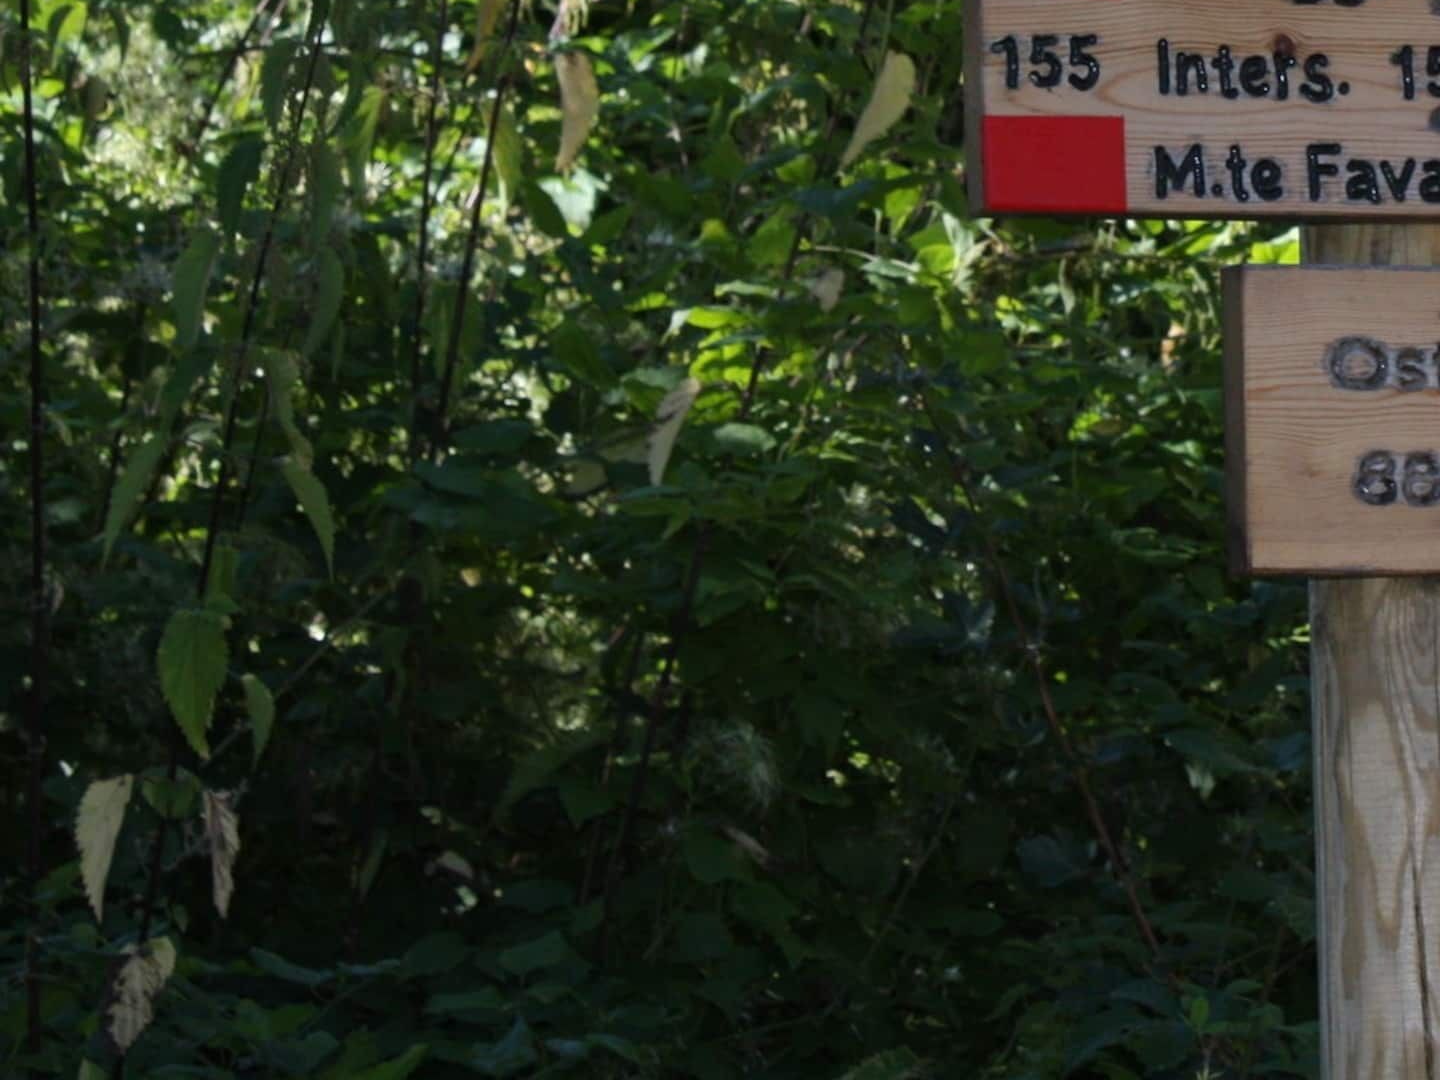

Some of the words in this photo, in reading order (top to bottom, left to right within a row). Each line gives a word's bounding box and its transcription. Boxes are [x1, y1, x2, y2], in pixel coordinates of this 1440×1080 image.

[990, 33, 1100, 91] 155
[1156, 37, 1350, 103] Inters.
[1153, 142, 1284, 203] M.te
